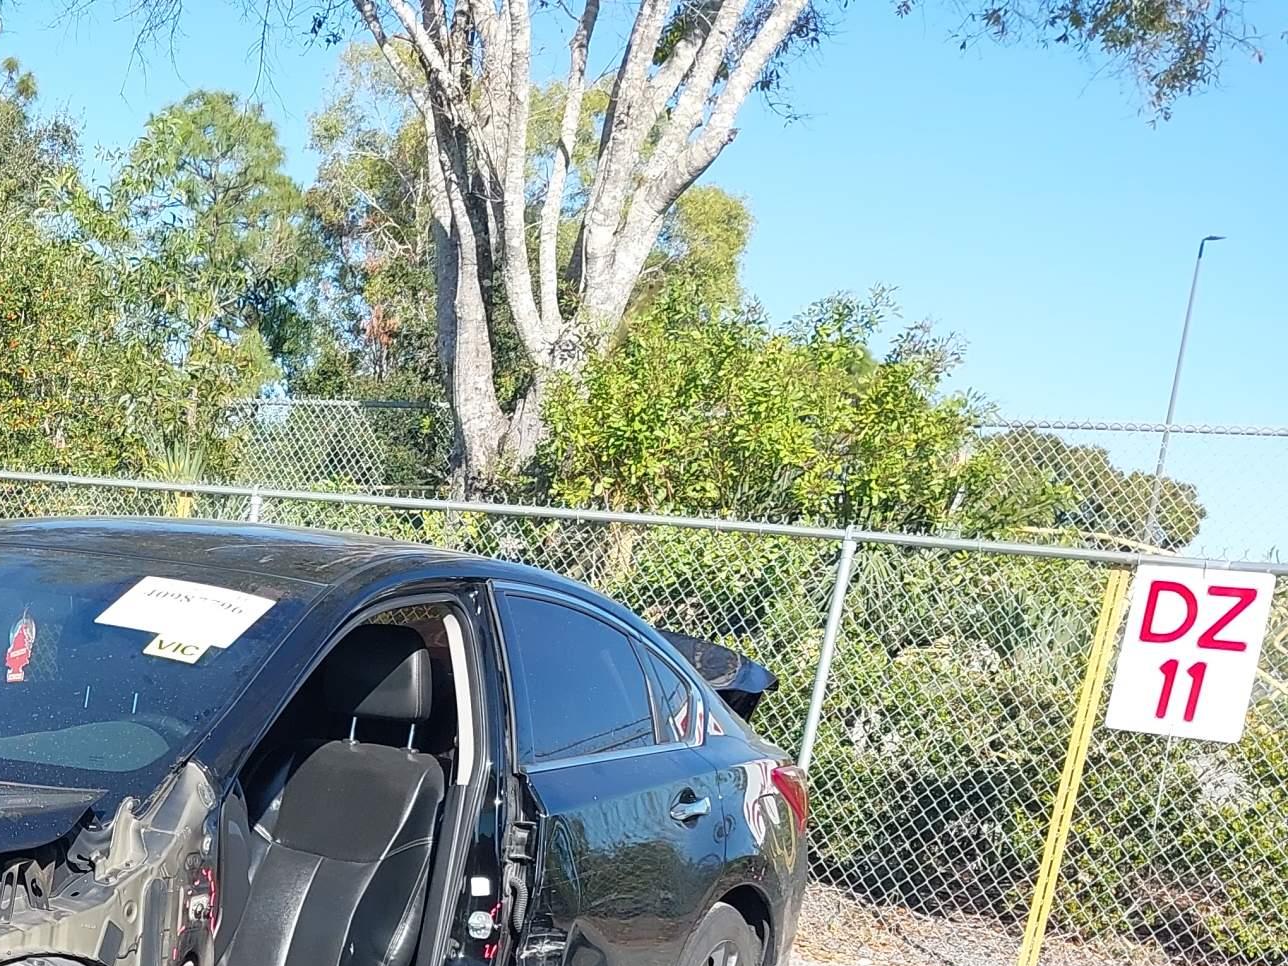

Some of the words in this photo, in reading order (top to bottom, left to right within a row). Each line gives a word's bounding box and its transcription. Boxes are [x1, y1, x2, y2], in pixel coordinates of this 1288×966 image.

[156, 639, 202, 657] VIC
[1138, 580, 1258, 652] DZ
[1155, 658, 1208, 722] 11
